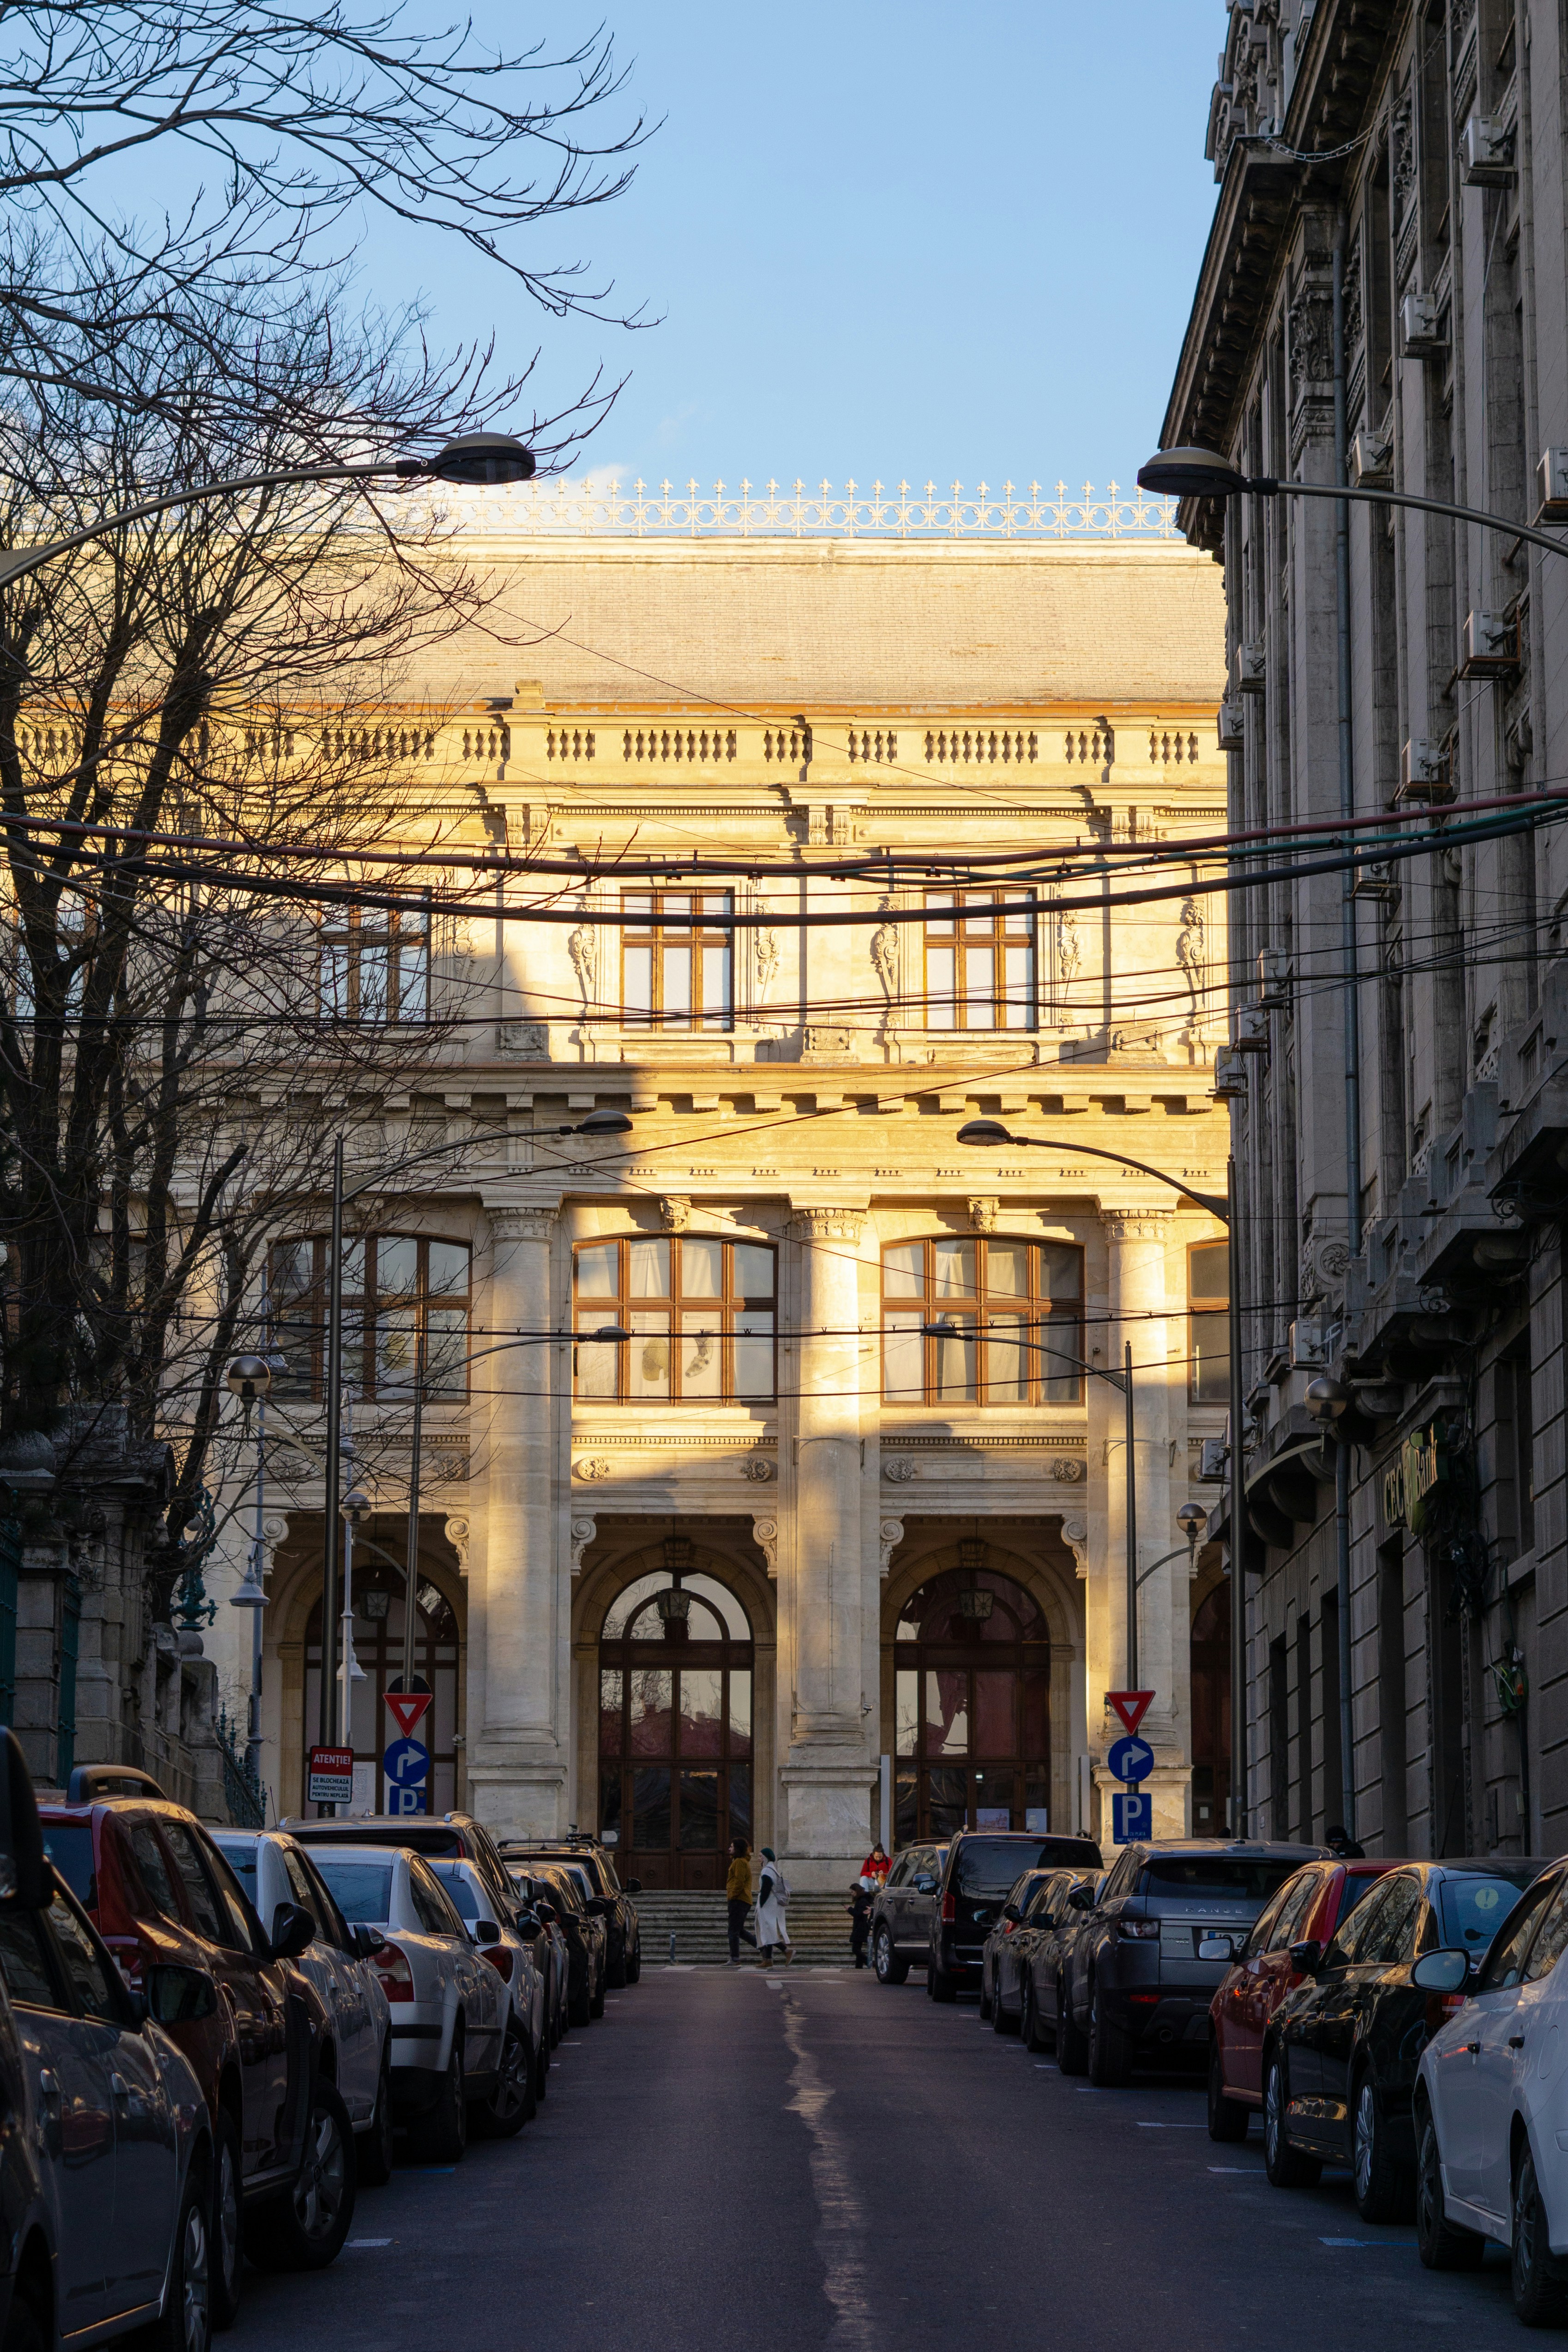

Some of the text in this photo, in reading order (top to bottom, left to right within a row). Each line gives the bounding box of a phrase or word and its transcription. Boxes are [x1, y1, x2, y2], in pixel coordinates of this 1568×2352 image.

[1385, 1422, 1438, 1527] CEC Bank
[314, 1754, 350, 1767] ATENȚIE!
[399, 1788, 417, 1815] P
[1122, 1796, 1142, 1836] P
